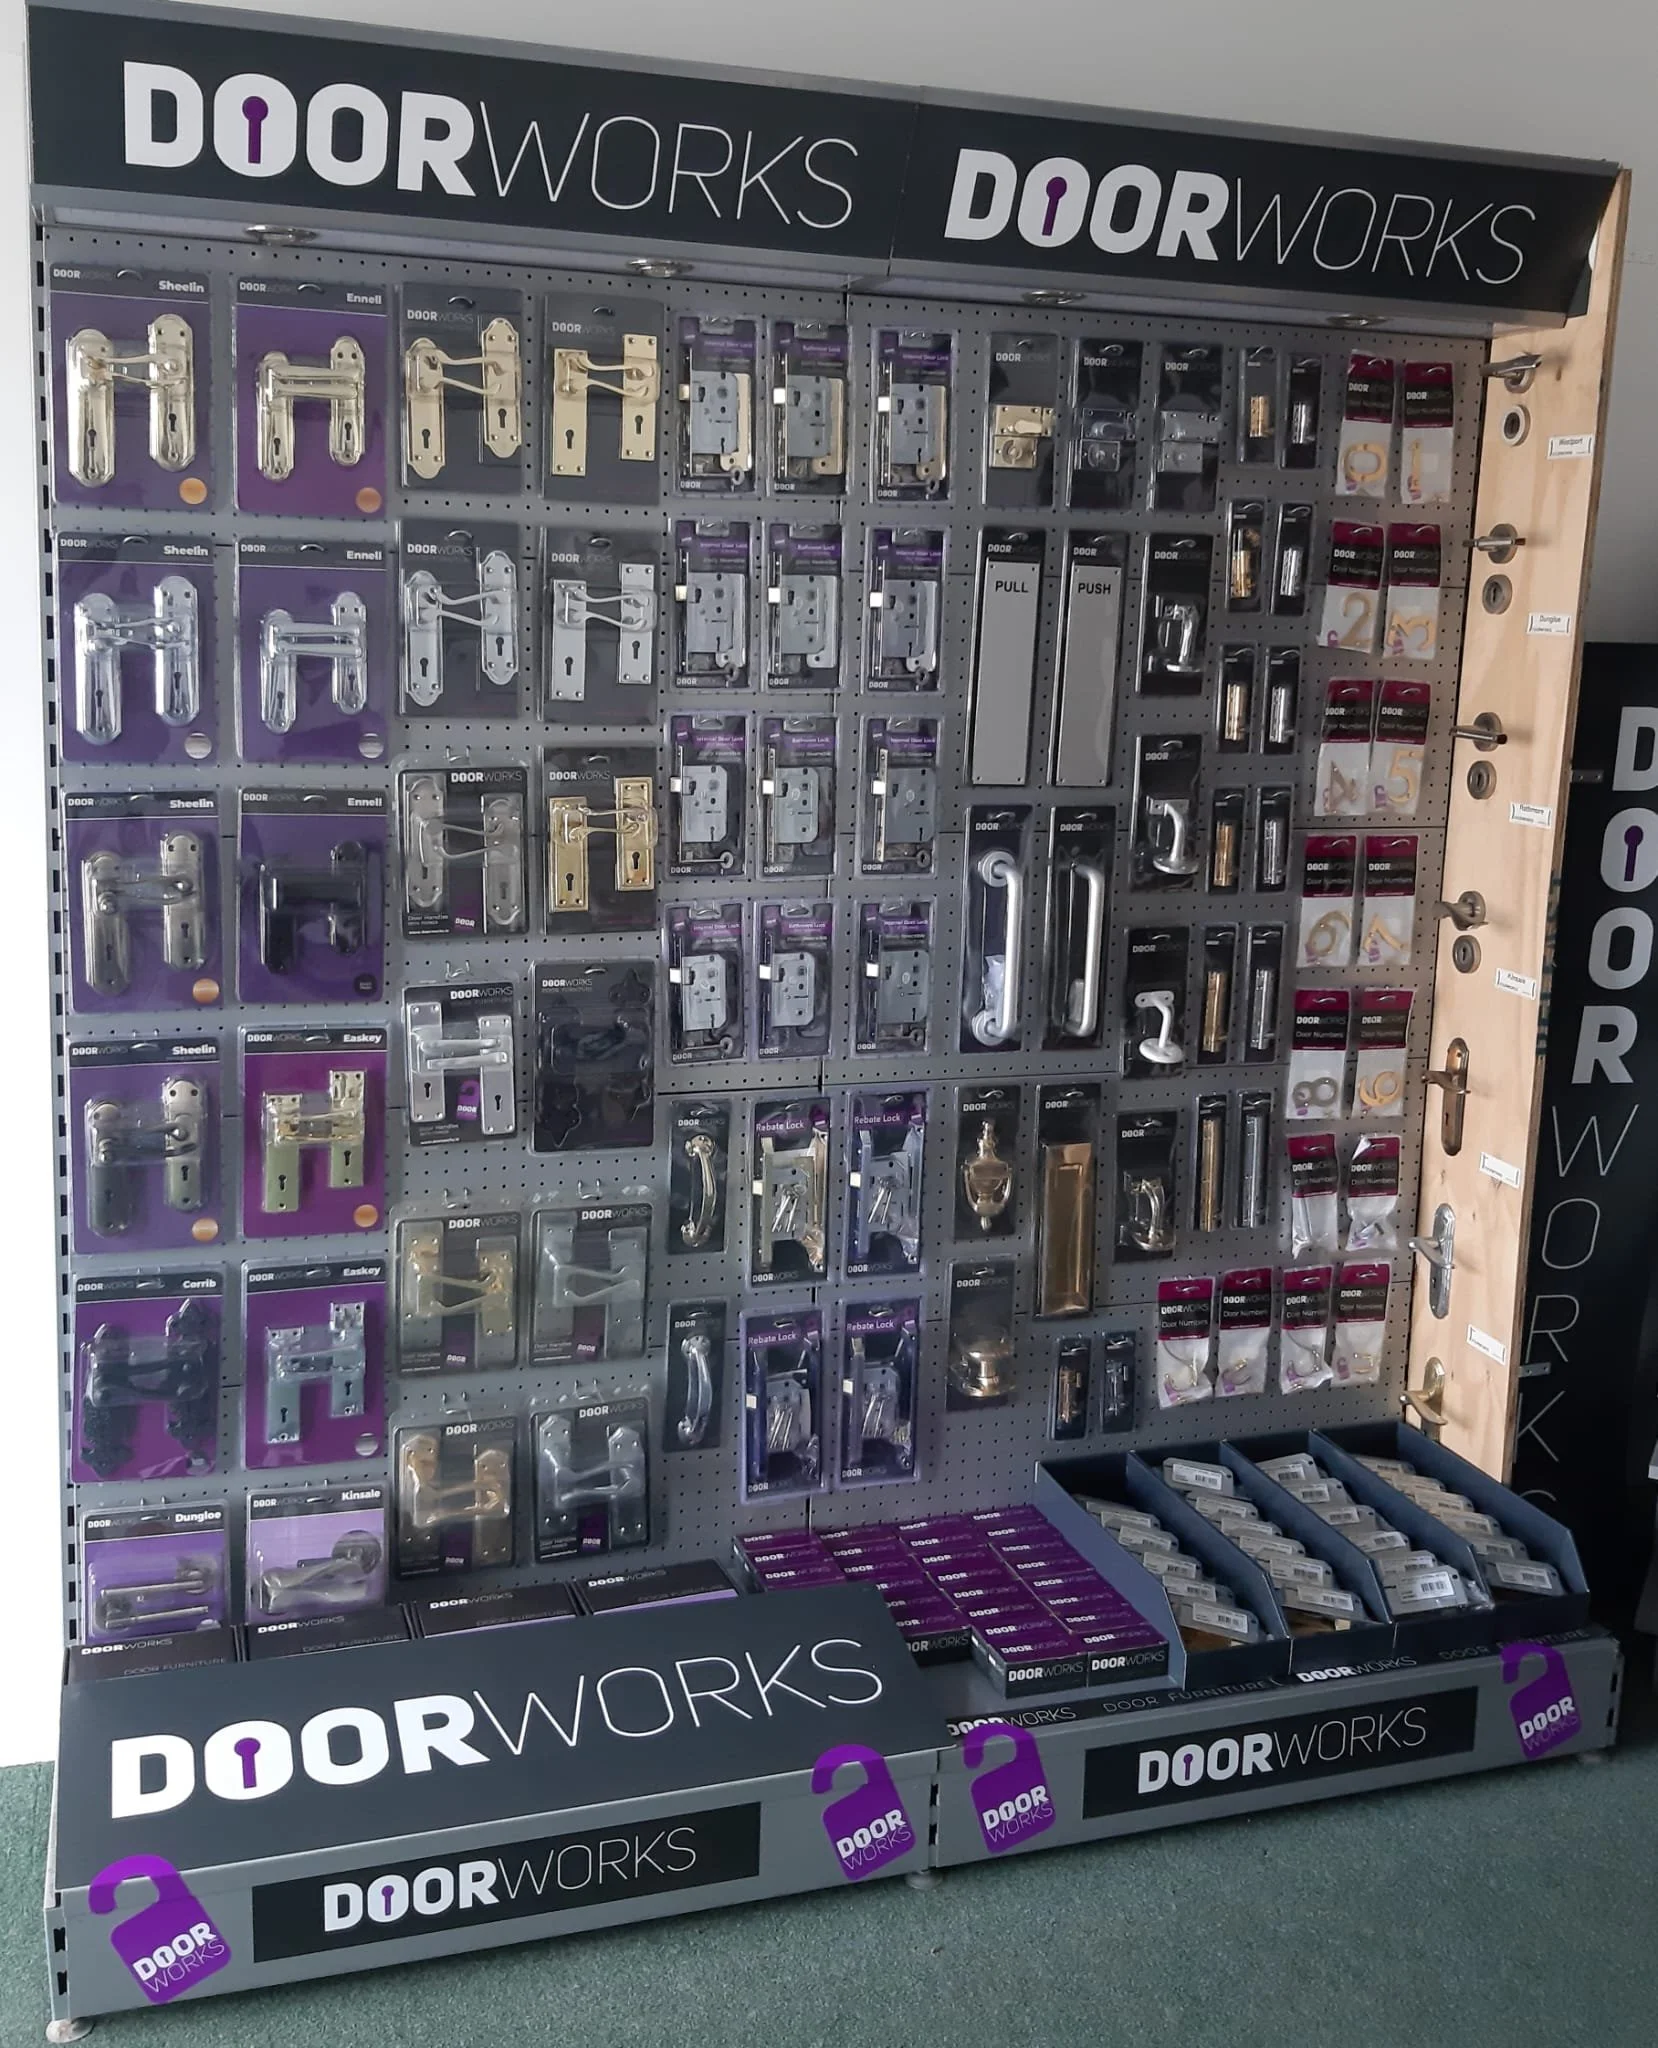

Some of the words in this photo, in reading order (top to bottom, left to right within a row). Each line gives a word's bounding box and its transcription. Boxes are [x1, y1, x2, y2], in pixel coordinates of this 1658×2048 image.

[123, 61, 859, 230] DOORWORKS
[943, 148, 1536, 286] DOORWORKS
[159, 280, 204, 293] Sheelin
[347, 292, 382, 305] Ennell
[163, 545, 209, 556] Sheelin
[346, 549, 382, 561] Ennell
[995, 580, 1029, 593] PULL
[1078, 582, 1112, 594] PUSH
[169, 799, 214, 809] Sheelin
[347, 798, 383, 807] Ennell
[343, 1033, 382, 1044] Easkey
[172, 1045, 216, 1056] Sheelin
[854, 1114, 881, 1124] Rebate
[882, 1113, 901, 1122] Lock
[756, 1122, 783, 1131] Rebate
[785, 1120, 804, 1130] Lock
[343, 1266, 381, 1277] Easkey
[182, 1279, 217, 1290] Corrib
[847, 1321, 875, 1331] Rebate
[875, 1319, 895, 1330] Lock
[748, 1334, 776, 1345] Rebate
[777, 1332, 798, 1343] Lock
[342, 1489, 381, 1501] Kinsale
[175, 1511, 221, 1524] Dungloe
[81, 1637, 173, 1655] DOORWORKS
[1092, 1652, 1166, 1672] DOORWORKS
[1008, 1662, 1084, 1682] DOORWORKS
[1296, 1656, 1417, 1684] DOORWORKS
[1103, 1696, 1158, 1712] DOOR
[1519, 1695, 1576, 1740] DOOR
[111, 1638, 883, 1820] DOORWORKS
[1138, 1707, 1427, 1795] DOORWORKS
[982, 1785, 1050, 1831] DOOR
[988, 1801, 1054, 1843] WORKS
[836, 1808, 907, 1860] DOOR
[844, 1826, 912, 1870] WORKS
[324, 1827, 697, 1932] DOORWORKS
[132, 1922, 217, 1981] DOOR
[145, 1938, 225, 1993] WORKS
